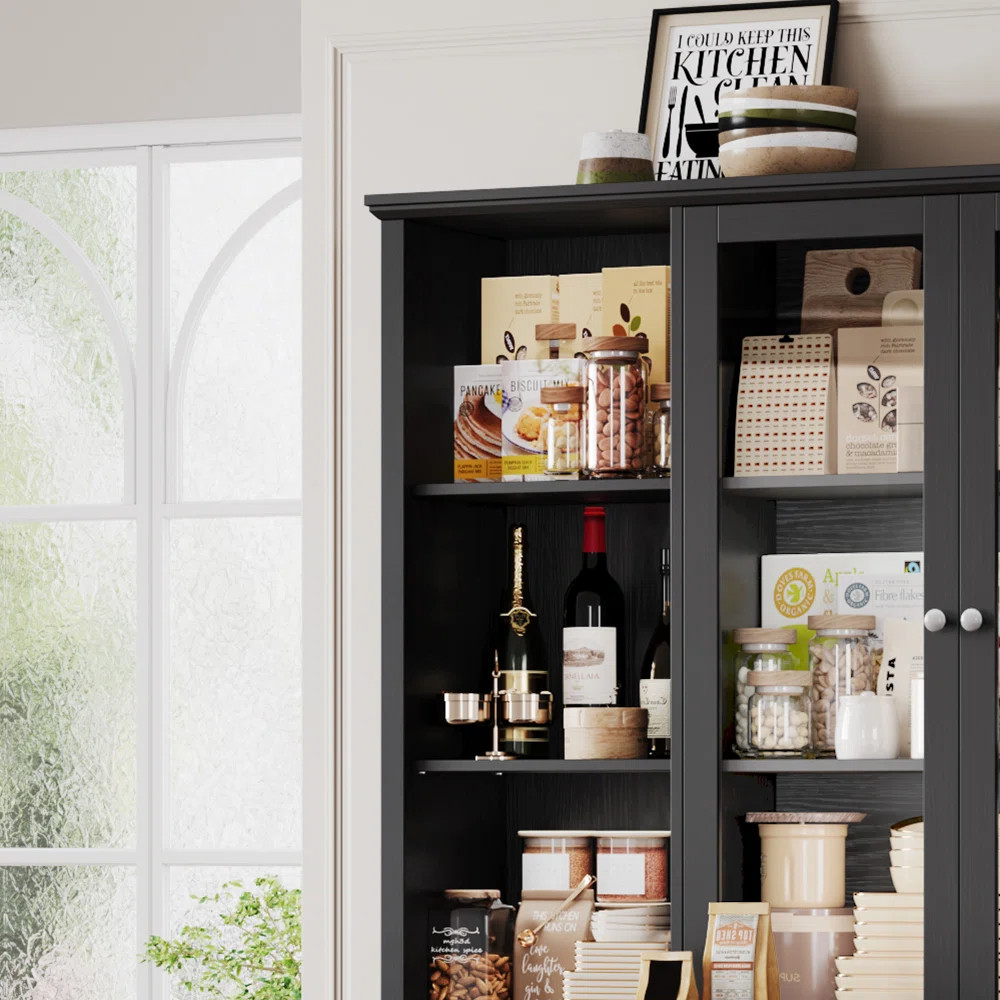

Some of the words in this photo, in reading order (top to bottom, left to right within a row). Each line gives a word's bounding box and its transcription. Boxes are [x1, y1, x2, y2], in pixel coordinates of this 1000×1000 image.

[678, 35, 682, 48] I
[687, 32, 733, 47] COULD
[738, 30, 774, 45] KEEP
[778, 27, 811, 42] THIS
[671, 44, 813, 86] KITCHEN
[655, 159, 726, 181] EATIN
[875, 588, 898, 601] Fibre
[886, 658, 896, 692] STA
